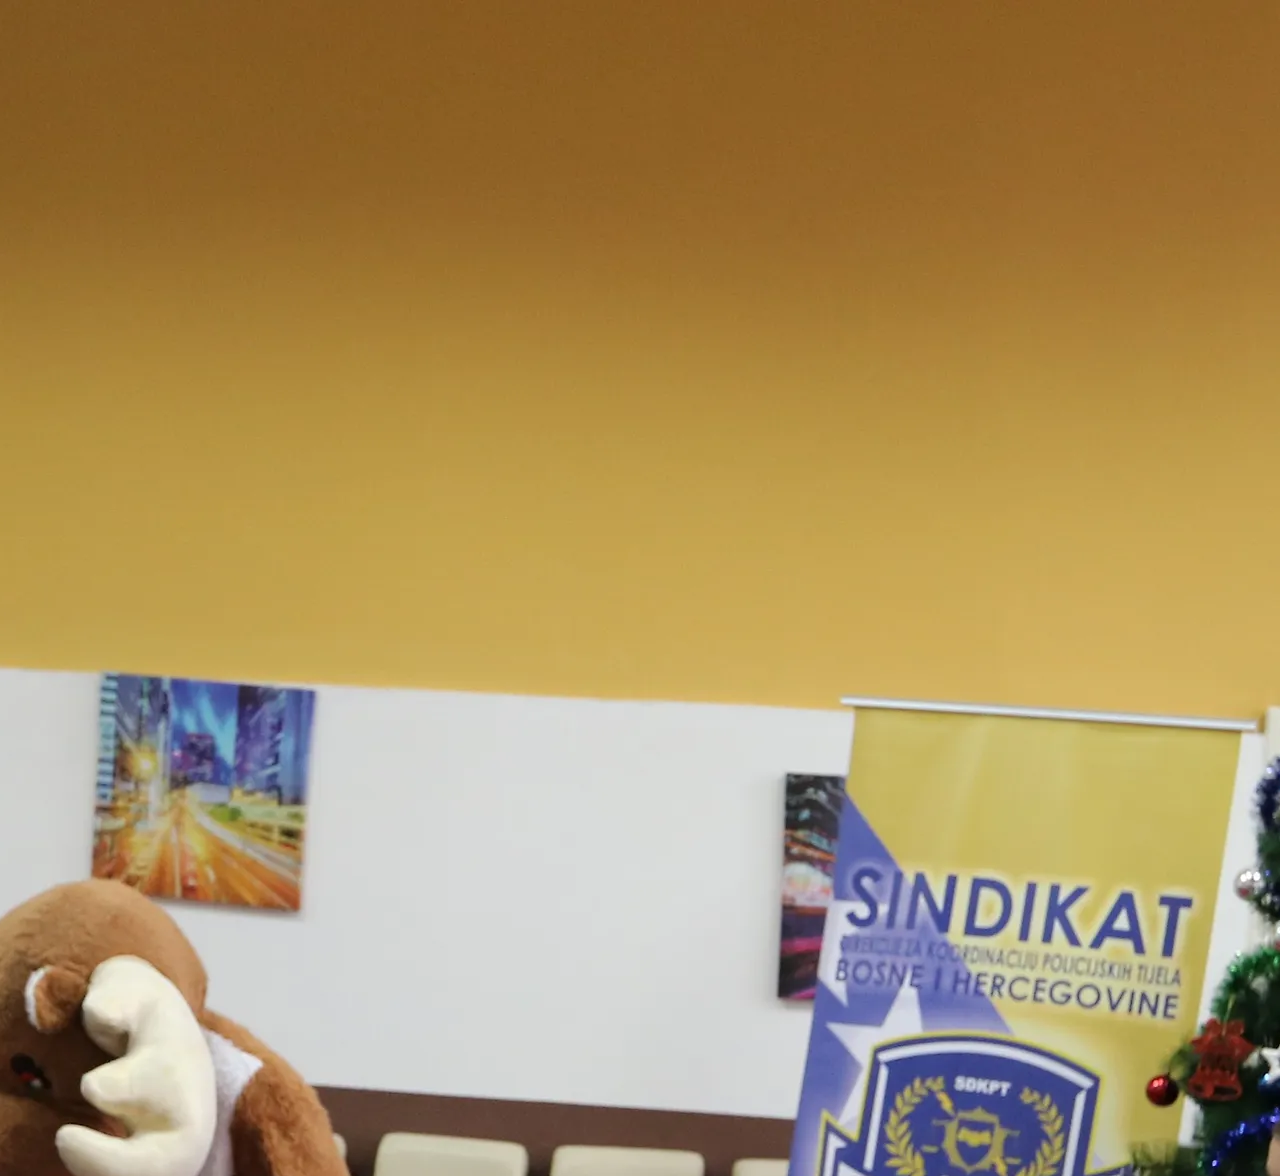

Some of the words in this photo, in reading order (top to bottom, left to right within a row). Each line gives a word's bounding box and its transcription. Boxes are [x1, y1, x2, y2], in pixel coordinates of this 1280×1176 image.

[846, 867, 1193, 958] SINDIKAT
[836, 959, 926, 990] BOSNE
[933, 967, 942, 991] I
[952, 969, 1180, 1019] HERCEGOVINE
[1042, 953, 1132, 981] POLICIJSKIH
[1137, 964, 1181, 987] TIJELA
[954, 1076, 1011, 1097] SDKPT
